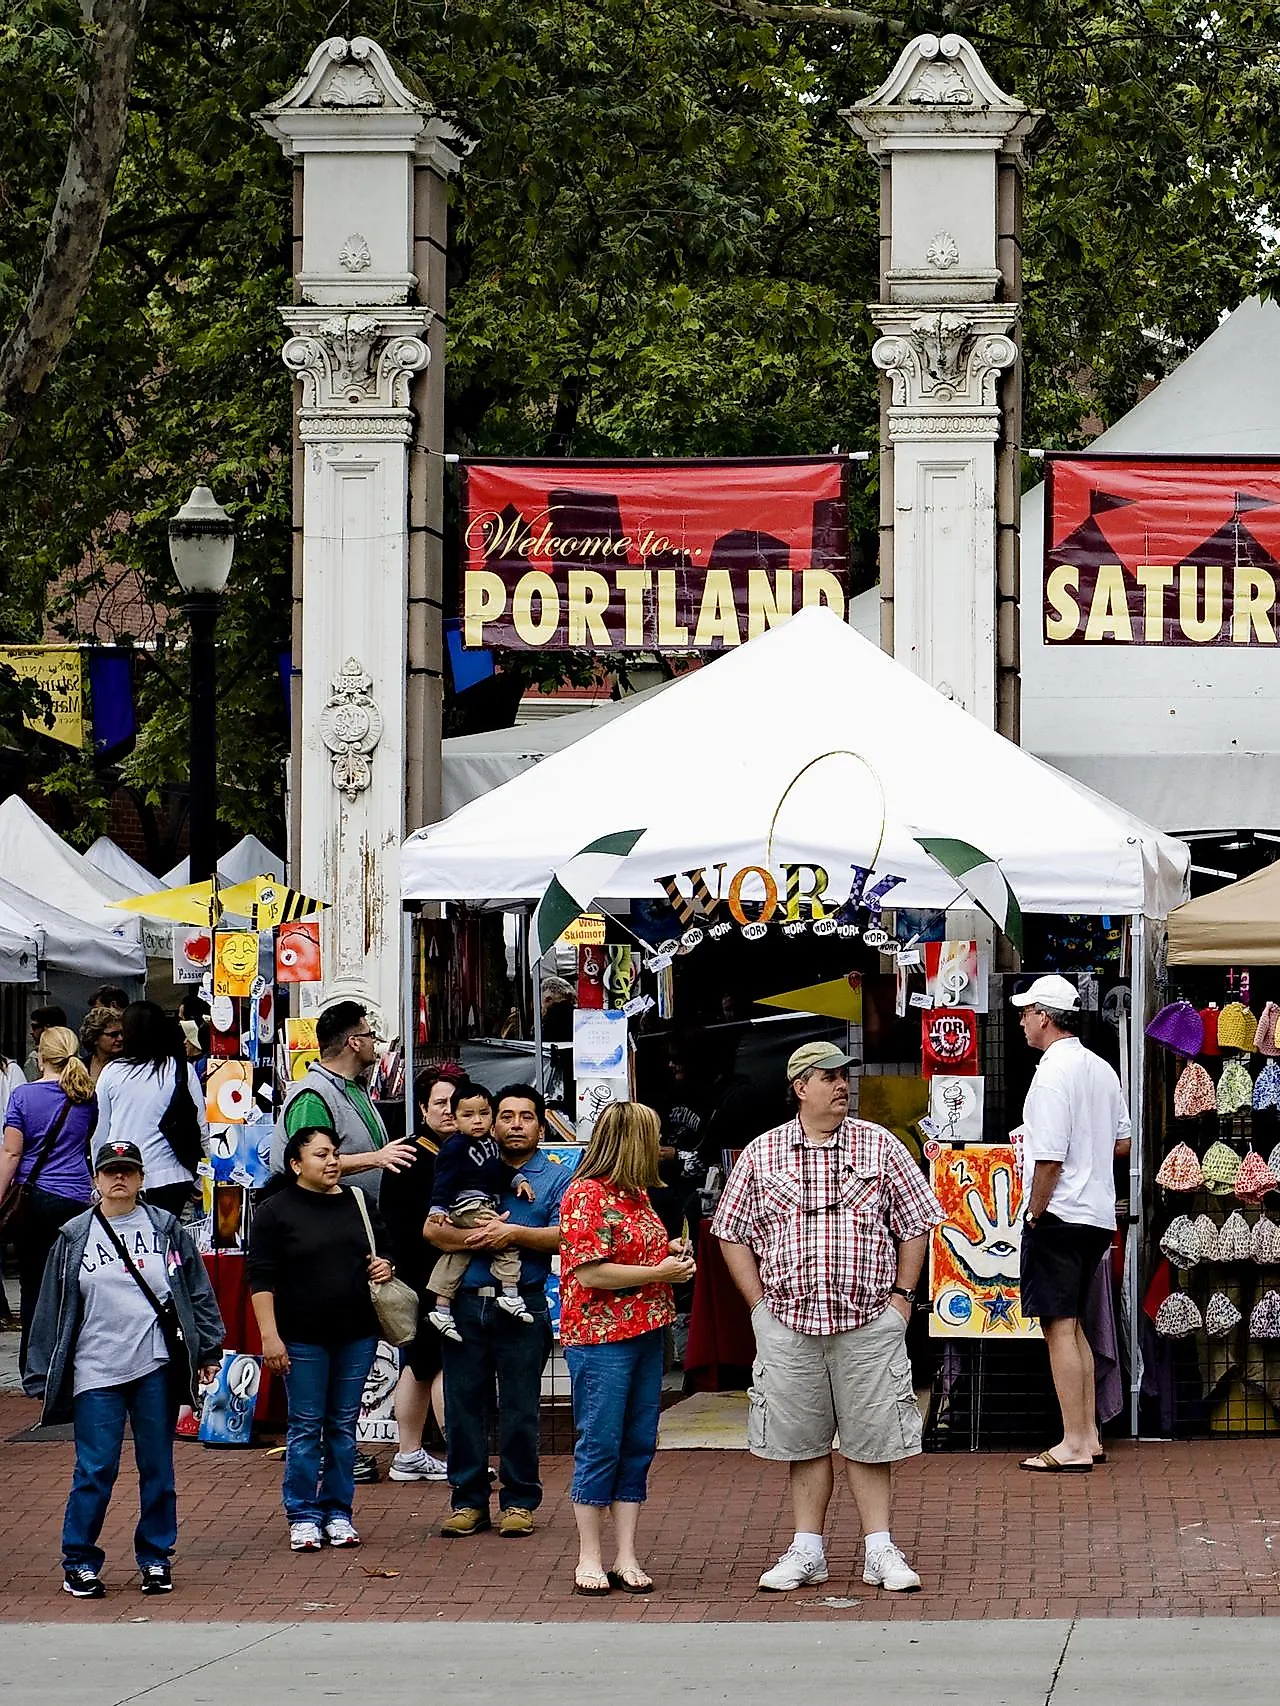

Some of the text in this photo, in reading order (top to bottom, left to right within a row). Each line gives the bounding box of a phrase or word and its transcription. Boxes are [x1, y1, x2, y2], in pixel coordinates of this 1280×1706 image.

[465, 505, 632, 561] Welcome
[464, 569, 845, 647] PORTLAND
[654, 863, 907, 930] WORK
[743, 923, 766, 937] WORK
[814, 920, 835, 933] WORK
[683, 930, 703, 945] WORK
[864, 932, 886, 943] WORK
[177, 967, 204, 980] Passio
[216, 980, 230, 995] Sol
